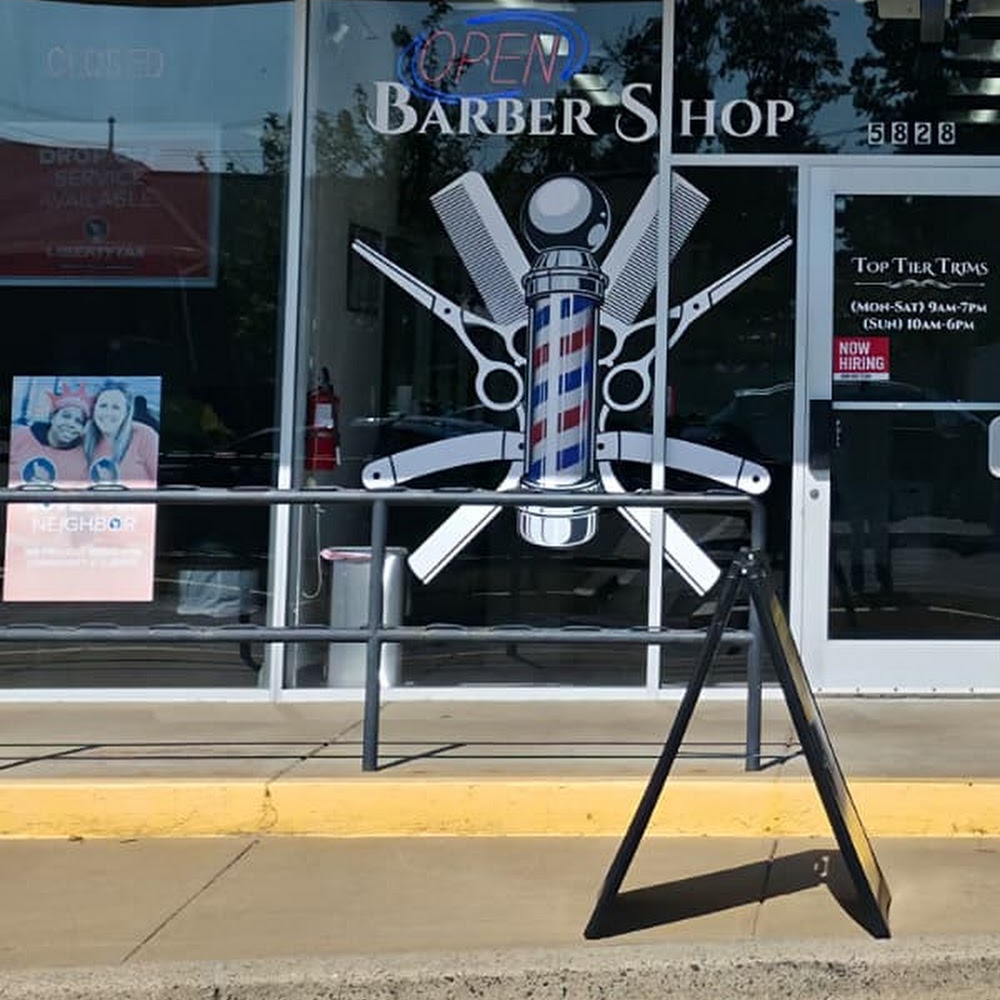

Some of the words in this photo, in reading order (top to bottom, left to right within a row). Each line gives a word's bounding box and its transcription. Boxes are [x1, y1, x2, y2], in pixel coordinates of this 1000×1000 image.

[419, 30, 561, 88] OPEN
[366, 81, 598, 137] BARBER
[615, 82, 795, 143] SHOP
[868, 122, 956, 145] 5828
[851, 257, 889, 274] TOP
[891, 257, 936, 276] TIER
[935, 257, 989, 276] TRIMS
[850, 301, 925, 313] (MON-SAT)
[928, 301, 988, 313] 9AM-7PM
[863, 318, 903, 330] (SUN)
[907, 318, 975, 330] 10AM-6PM
[839, 340, 872, 355] NOW
[839, 355, 885, 370] HIRING
[32, 515, 136, 533] NEIGHBOR
